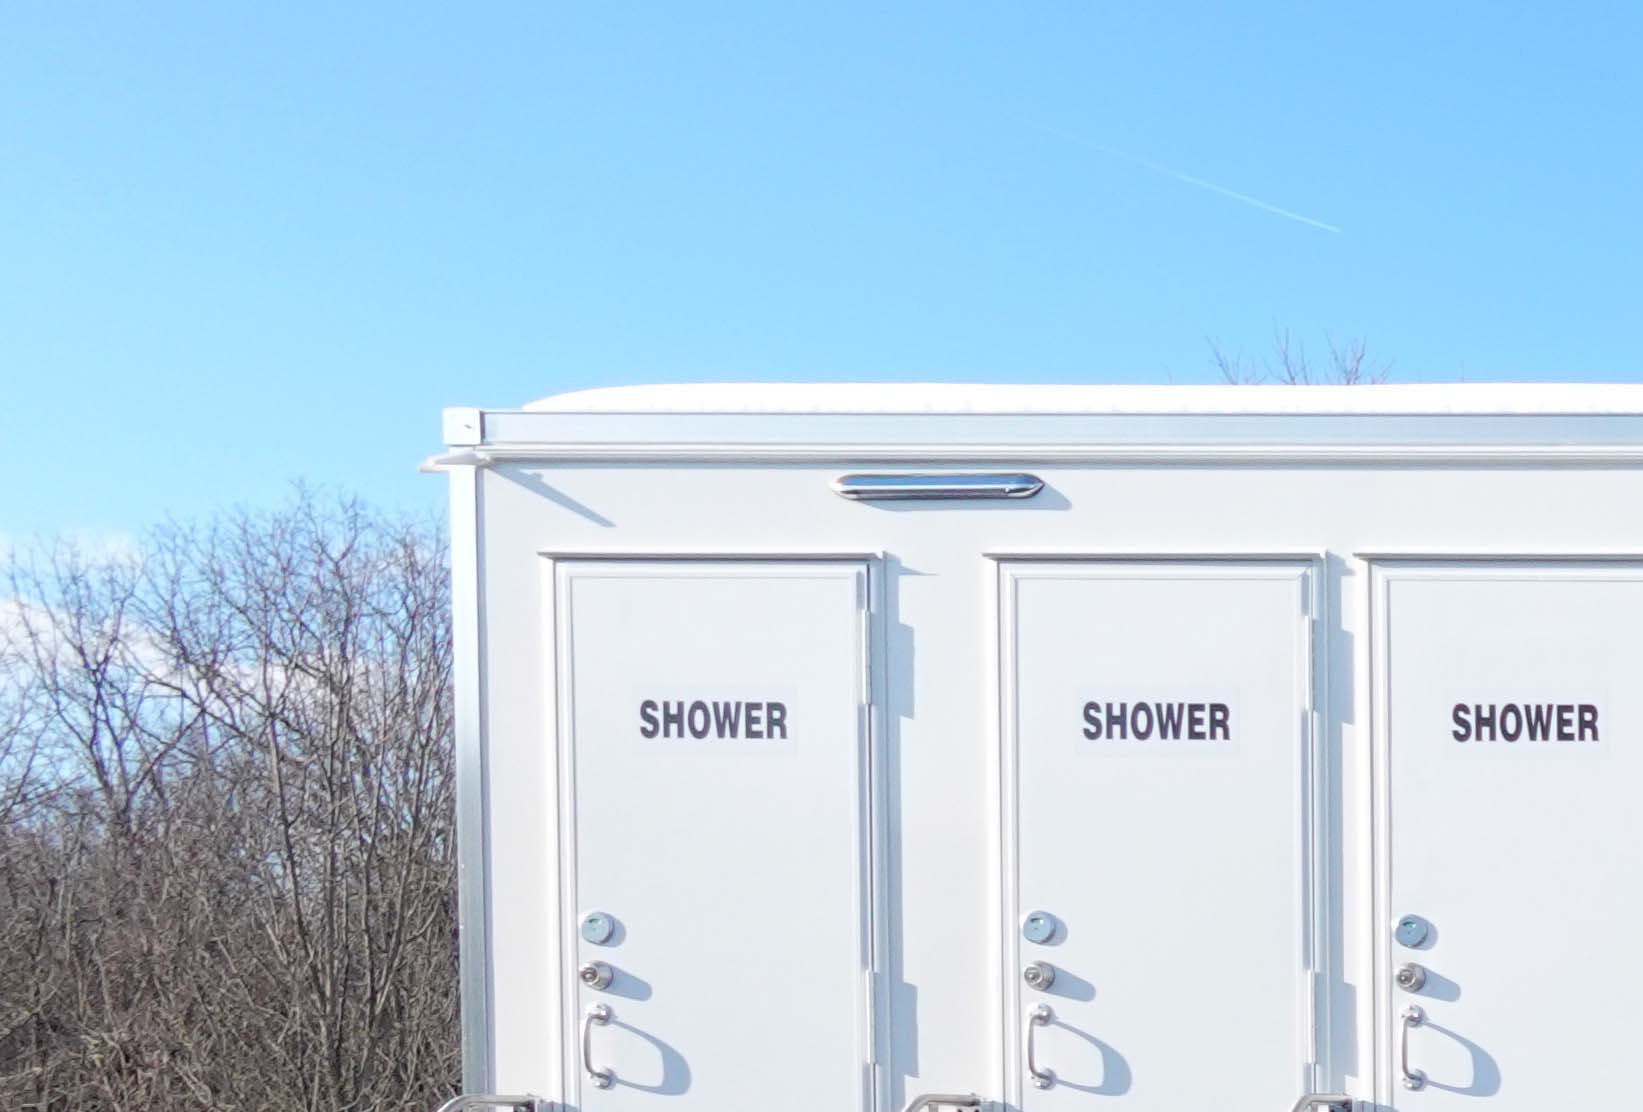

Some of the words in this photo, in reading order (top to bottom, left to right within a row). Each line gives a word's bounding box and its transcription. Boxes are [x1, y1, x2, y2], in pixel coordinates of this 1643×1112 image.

[640, 700, 786, 739] SHOWER
[1083, 702, 1230, 741] SHOWER
[1452, 703, 1599, 742] SHOWER
